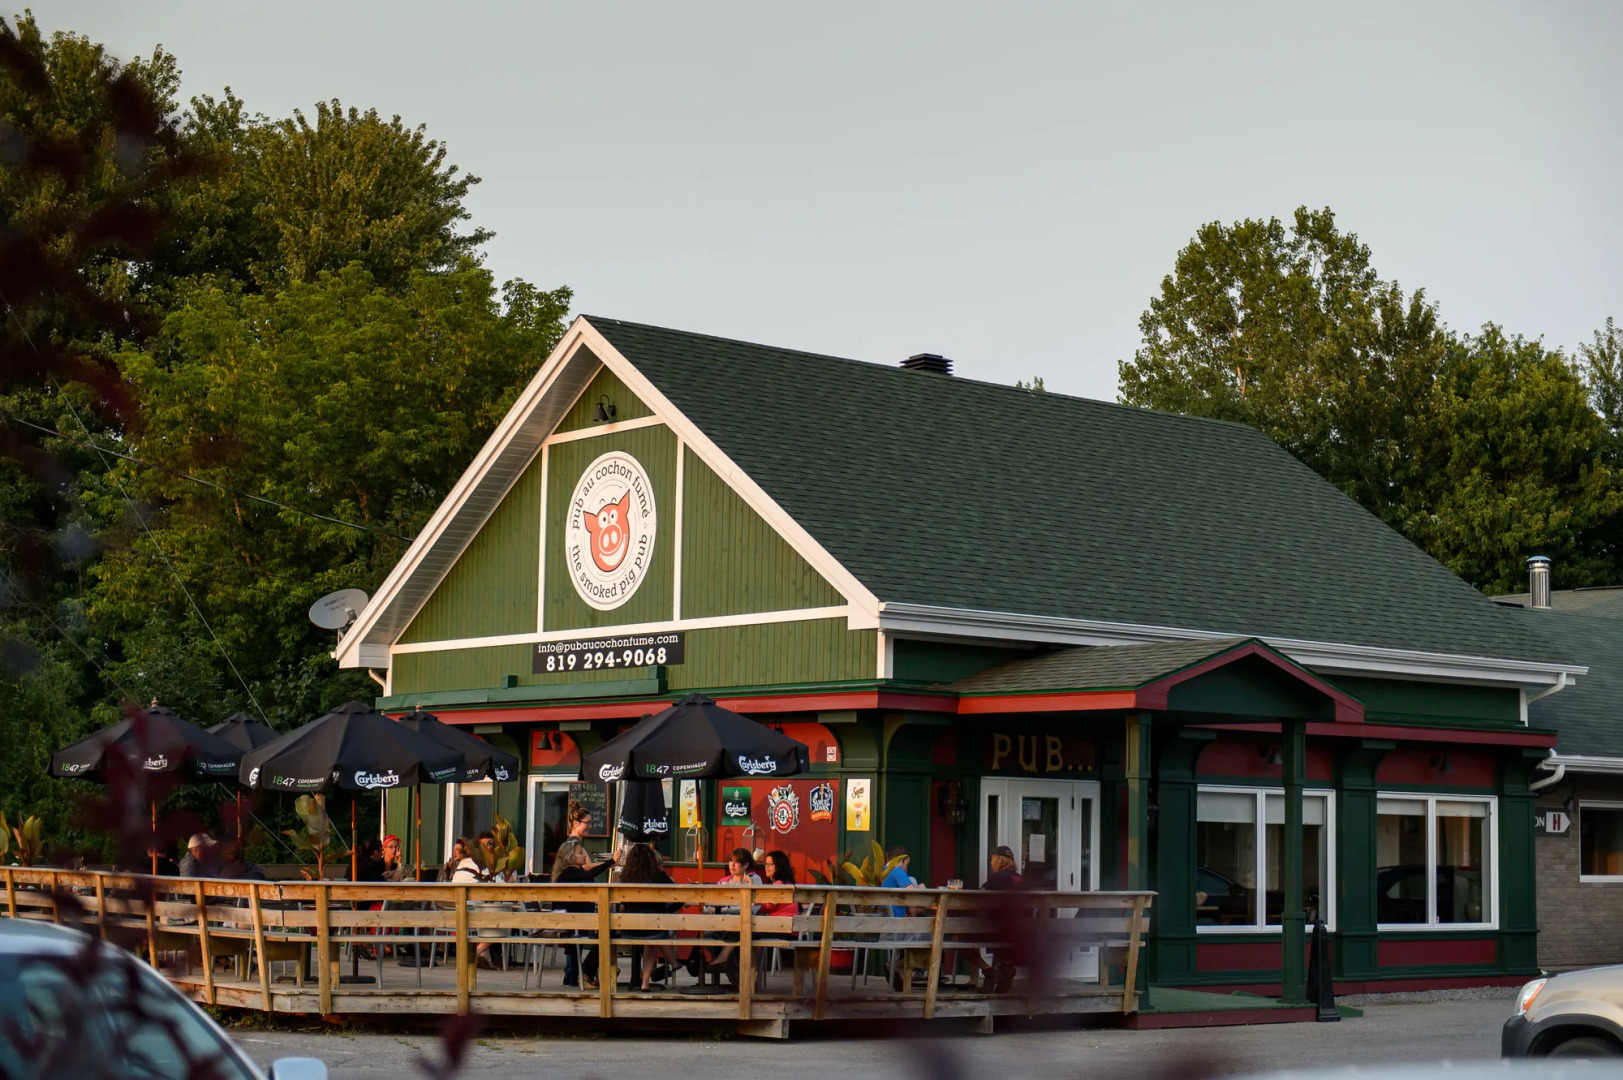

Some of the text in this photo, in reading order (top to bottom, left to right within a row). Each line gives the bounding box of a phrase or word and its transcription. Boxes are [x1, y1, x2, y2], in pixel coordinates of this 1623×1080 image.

[572, 461, 650, 530] pub au cochon fumé
[572, 534, 648, 598] the smoked pig pub
[538, 634, 679, 654] info@pubaucochonfume.com
[546, 647, 667, 672] 819 294-9068
[62, 763, 79, 772] 1847
[143, 754, 168, 770] sberg
[646, 763, 669, 774] 1847
[672, 761, 707, 771] COPENHAGUE
[738, 751, 776, 775] Carlsberg
[273, 776, 295, 787] 1847
[354, 769, 399, 789] Carlsberg
[725, 802, 748, 817] Carlsberg
